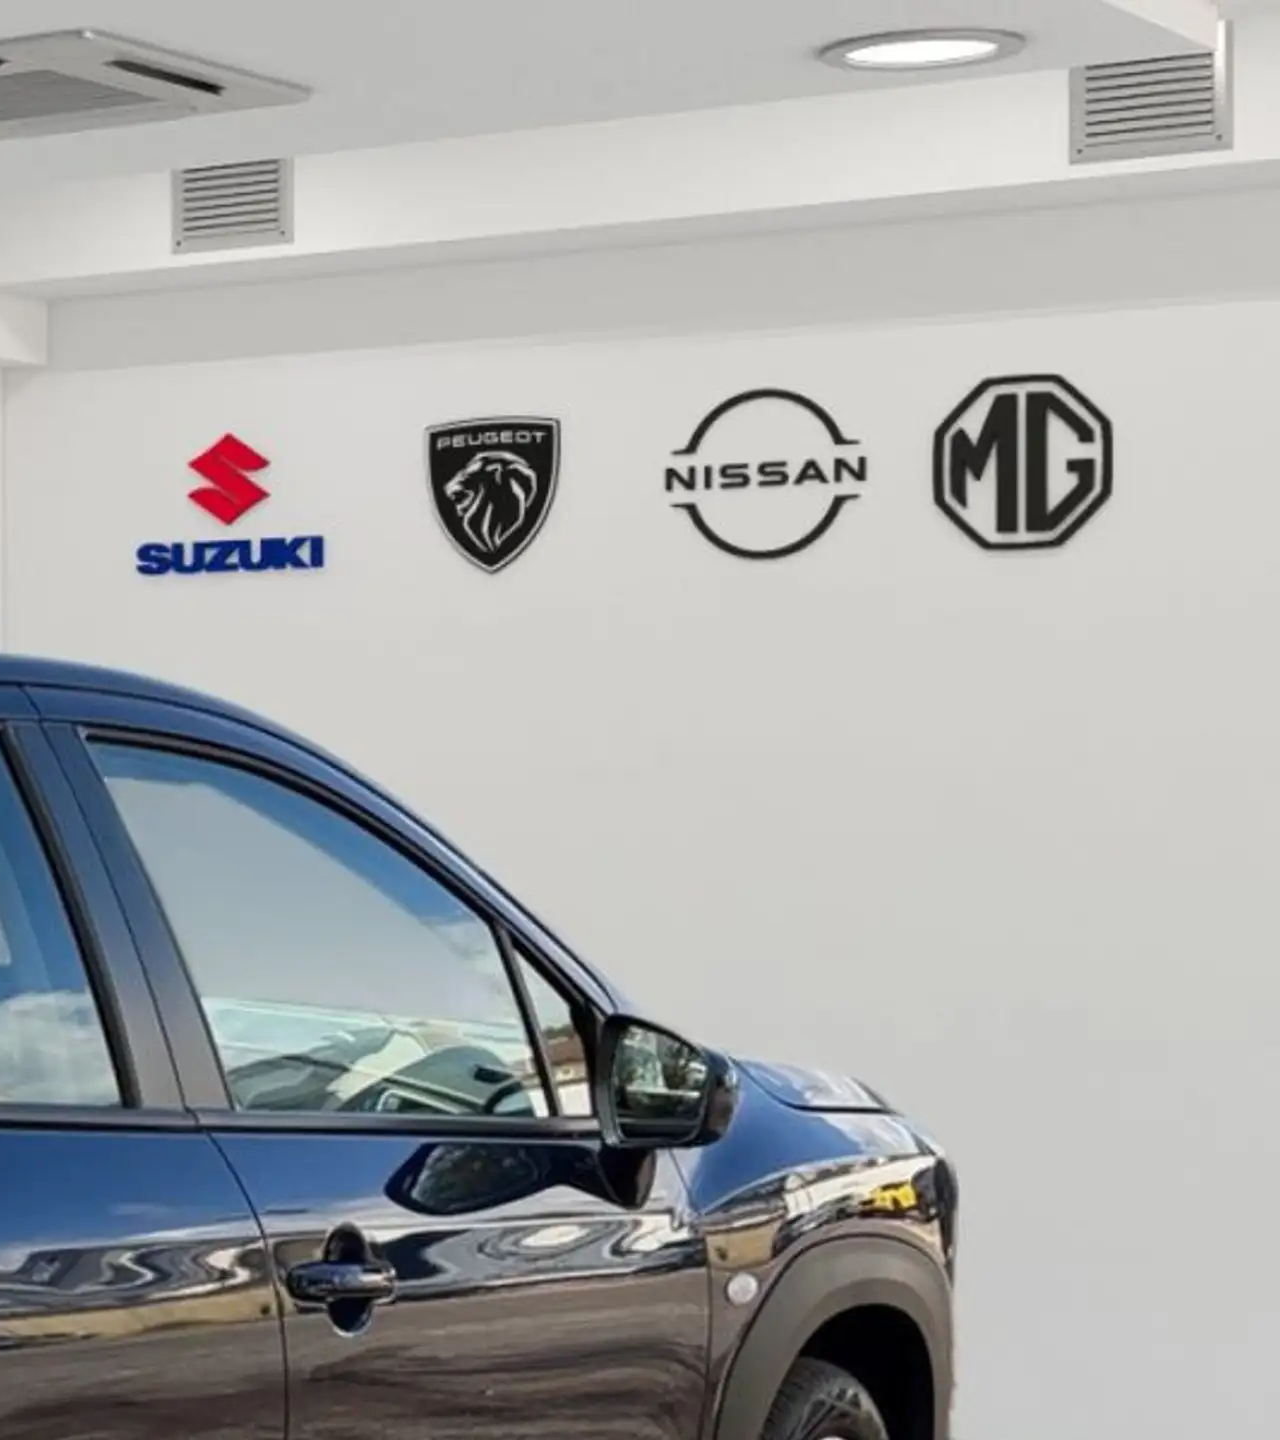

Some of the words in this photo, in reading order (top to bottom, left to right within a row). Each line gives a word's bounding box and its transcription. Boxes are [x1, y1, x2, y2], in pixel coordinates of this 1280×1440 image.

[436, 429, 547, 450] PEUGEOT
[664, 457, 867, 494] NISSAN
[950, 391, 1095, 533] MG
[136, 535, 325, 576] SUZUKI
